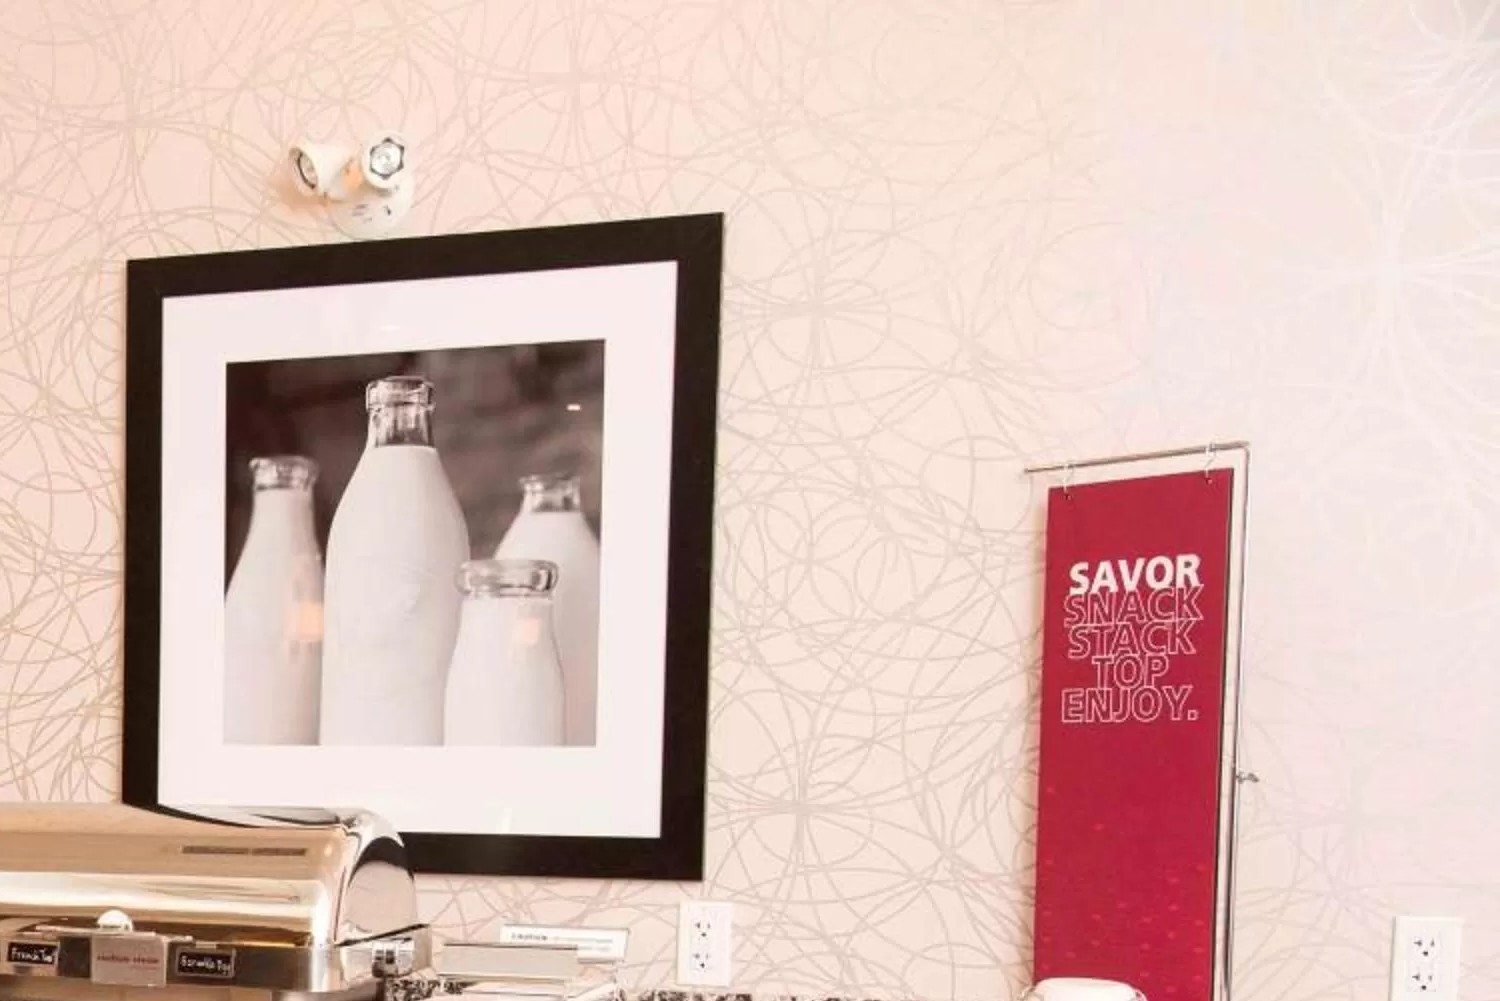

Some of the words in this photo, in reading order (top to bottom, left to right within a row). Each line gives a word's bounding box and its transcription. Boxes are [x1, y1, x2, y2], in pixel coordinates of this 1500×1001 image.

[1068, 554, 1204, 596] SAVOR
[1063, 584, 1204, 628] SNACK
[1068, 618, 1196, 659] STACK
[1092, 653, 1169, 689] TOP
[1061, 684, 1198, 723] ENJOY.
